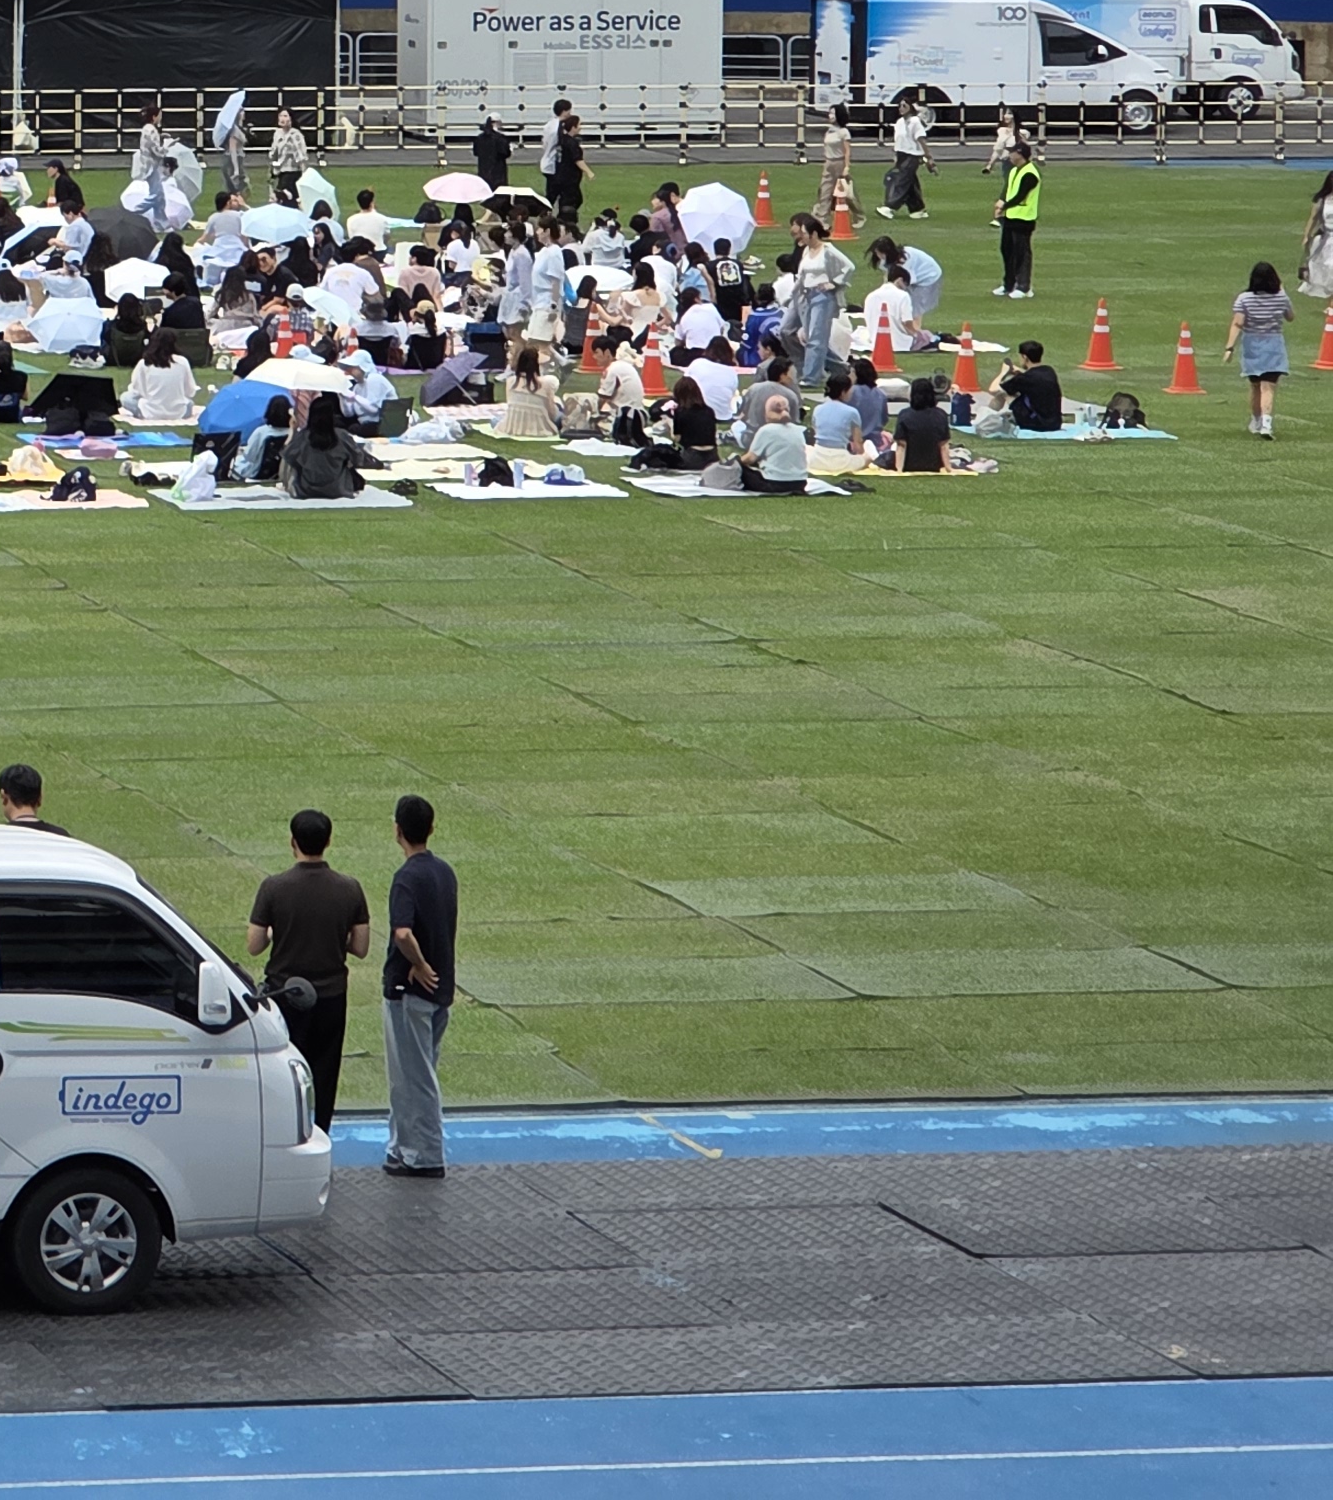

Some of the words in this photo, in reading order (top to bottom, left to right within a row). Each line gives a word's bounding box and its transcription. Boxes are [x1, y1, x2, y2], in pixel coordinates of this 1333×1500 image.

[473, 11, 546, 32] Power
[549, 15, 575, 32] as
[579, 15, 592, 31] a
[596, 9, 682, 32] Service
[997, 6, 1027, 21] 100
[580, 34, 613, 50] ESS
[616, 34, 647, 50] 리스
[72, 1080, 172, 1126] indego
